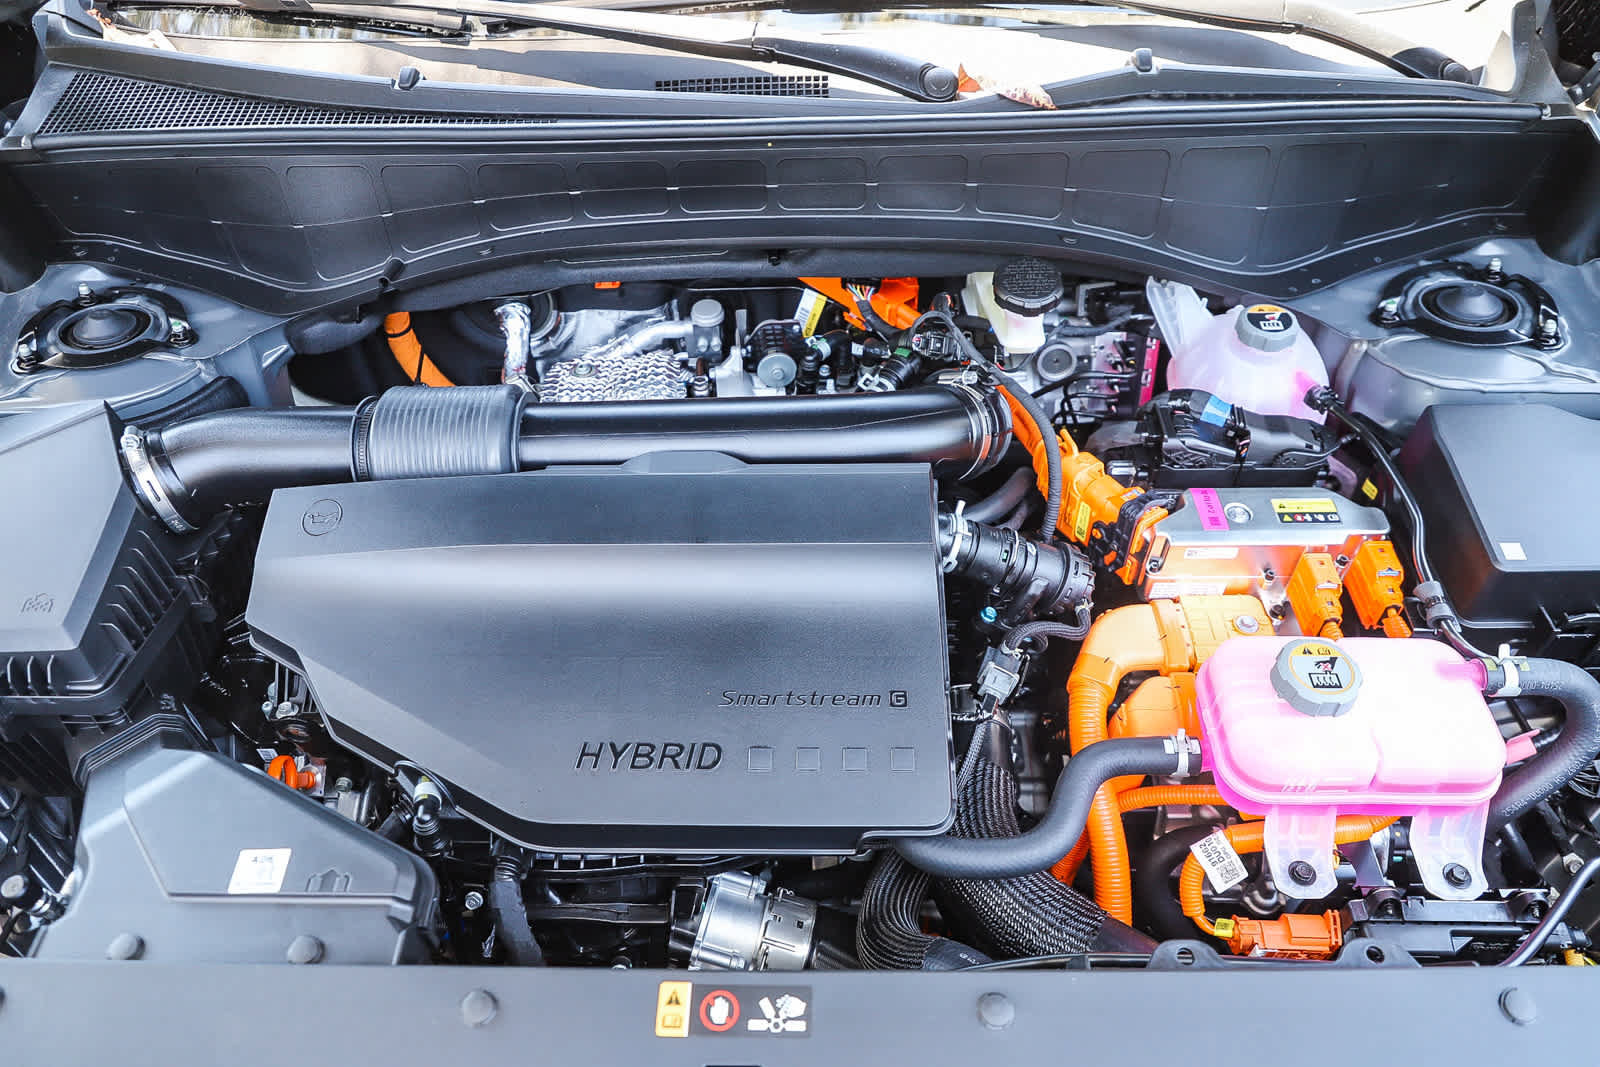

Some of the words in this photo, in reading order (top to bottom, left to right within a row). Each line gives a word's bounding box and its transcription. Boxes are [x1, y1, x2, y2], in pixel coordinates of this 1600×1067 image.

[718, 690, 882, 708] Smartstream
[888, 689, 909, 709] G
[575, 741, 724, 772] HYBRID
[1199, 842, 1219, 867] 91662
